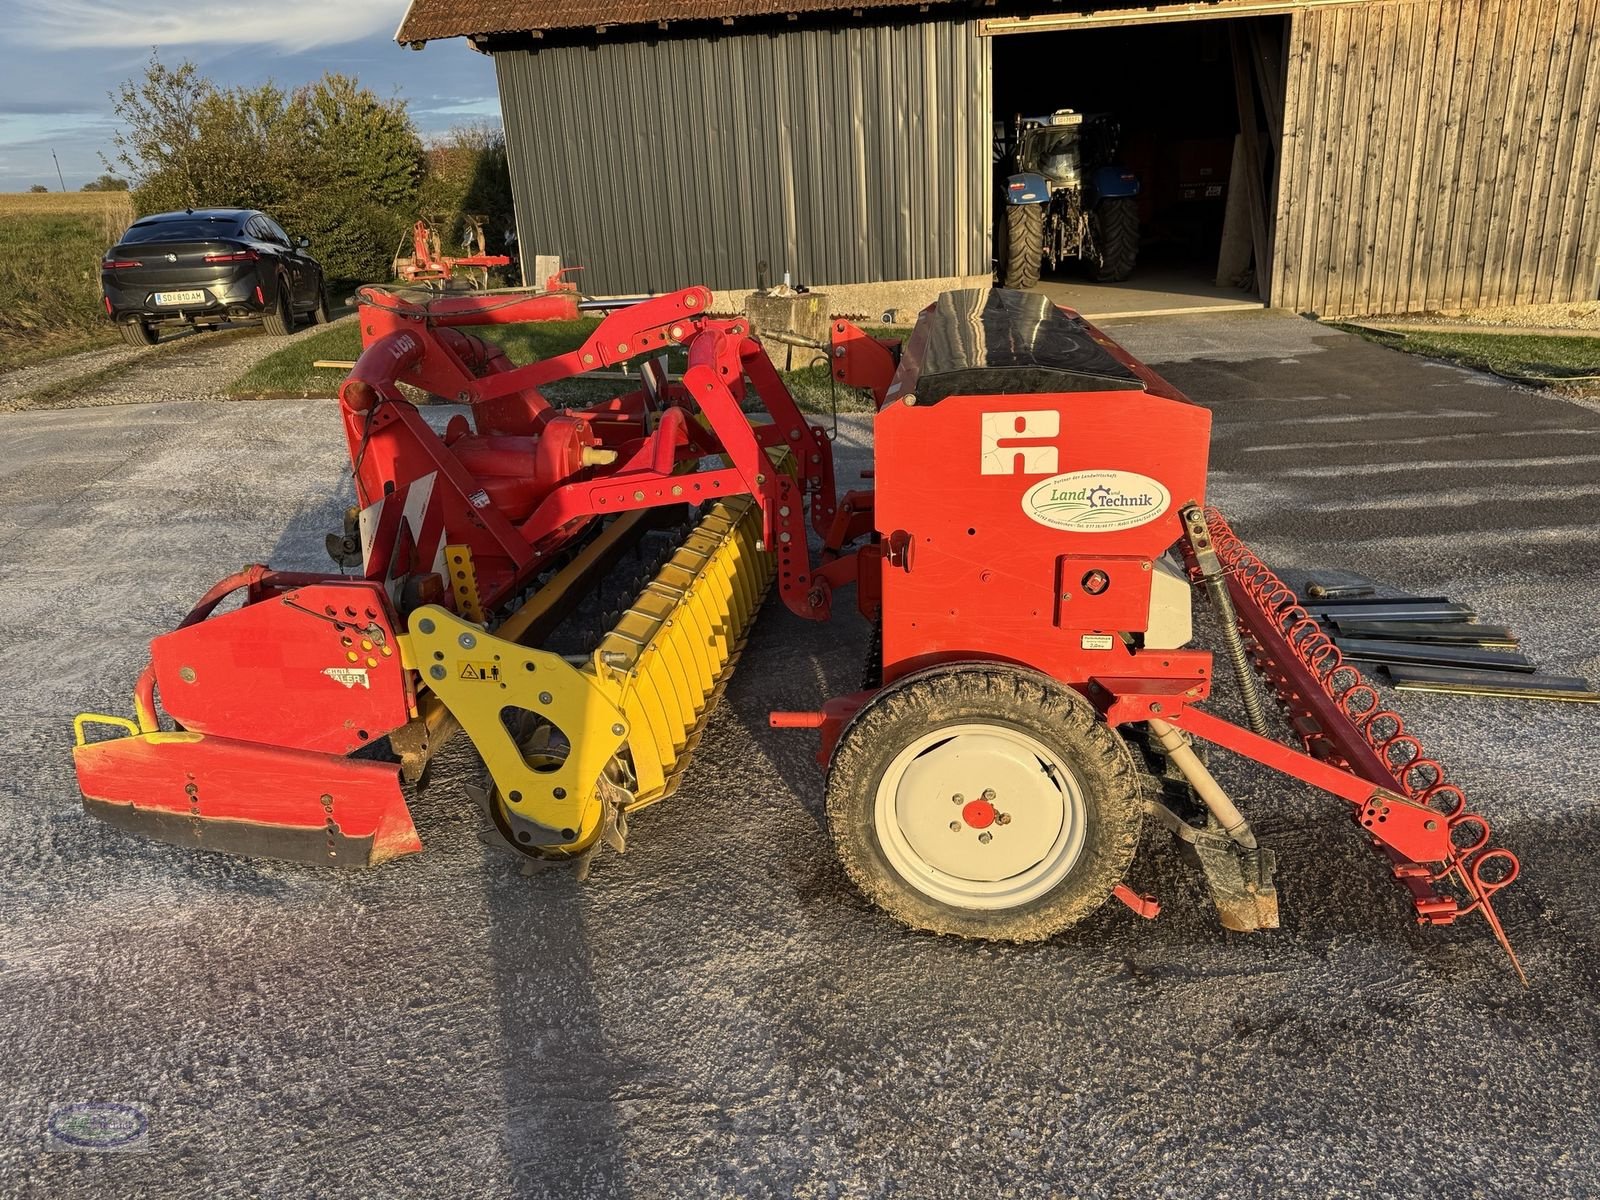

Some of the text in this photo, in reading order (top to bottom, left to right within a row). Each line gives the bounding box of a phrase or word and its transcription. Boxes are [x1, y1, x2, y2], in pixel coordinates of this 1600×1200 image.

[163, 294, 172, 302] SD
[177, 292, 190, 301] 810
[388, 334, 416, 359] LION
[1050, 488, 1087, 501] Land
[1098, 494, 1153, 507] Technik
